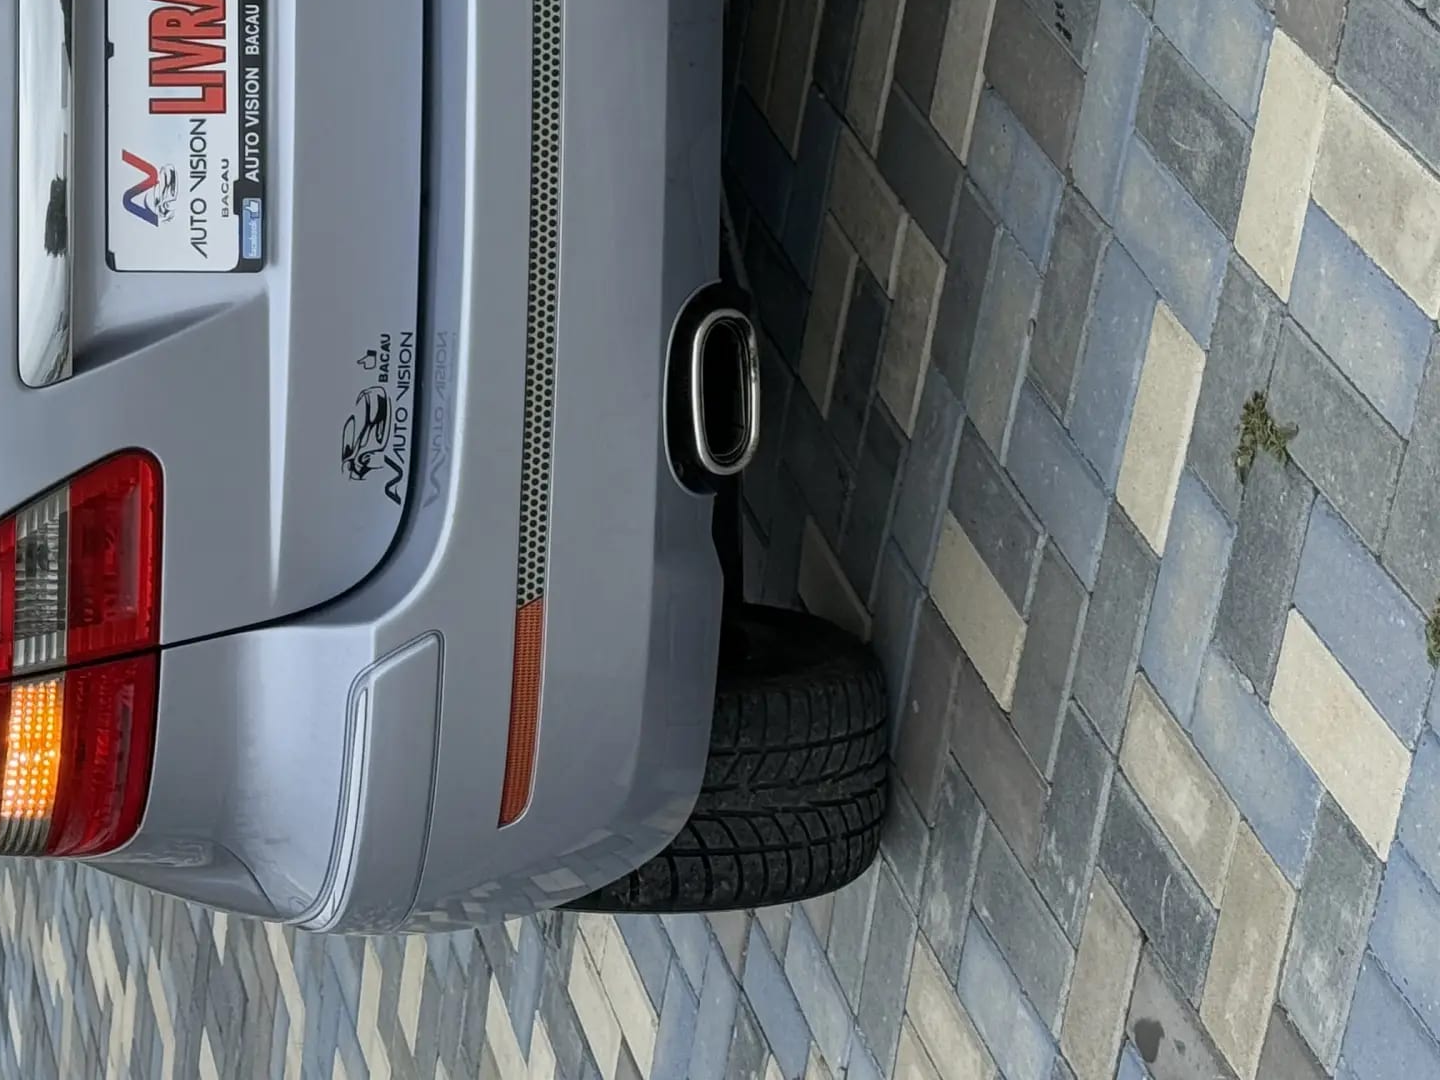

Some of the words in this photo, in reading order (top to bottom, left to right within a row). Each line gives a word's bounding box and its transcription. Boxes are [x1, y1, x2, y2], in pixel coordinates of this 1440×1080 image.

[244, 4, 260, 55] BACAU
[244, 67, 260, 127] VISION
[189, 118, 207, 192] VISION
[244, 132, 260, 182] AUTO
[221, 158, 229, 218] BACAU
[190, 198, 208, 259] AUTO
[378, 333, 391, 383] BACAU
[394, 331, 414, 401] VISION
[392, 407, 408, 464] AUTO
